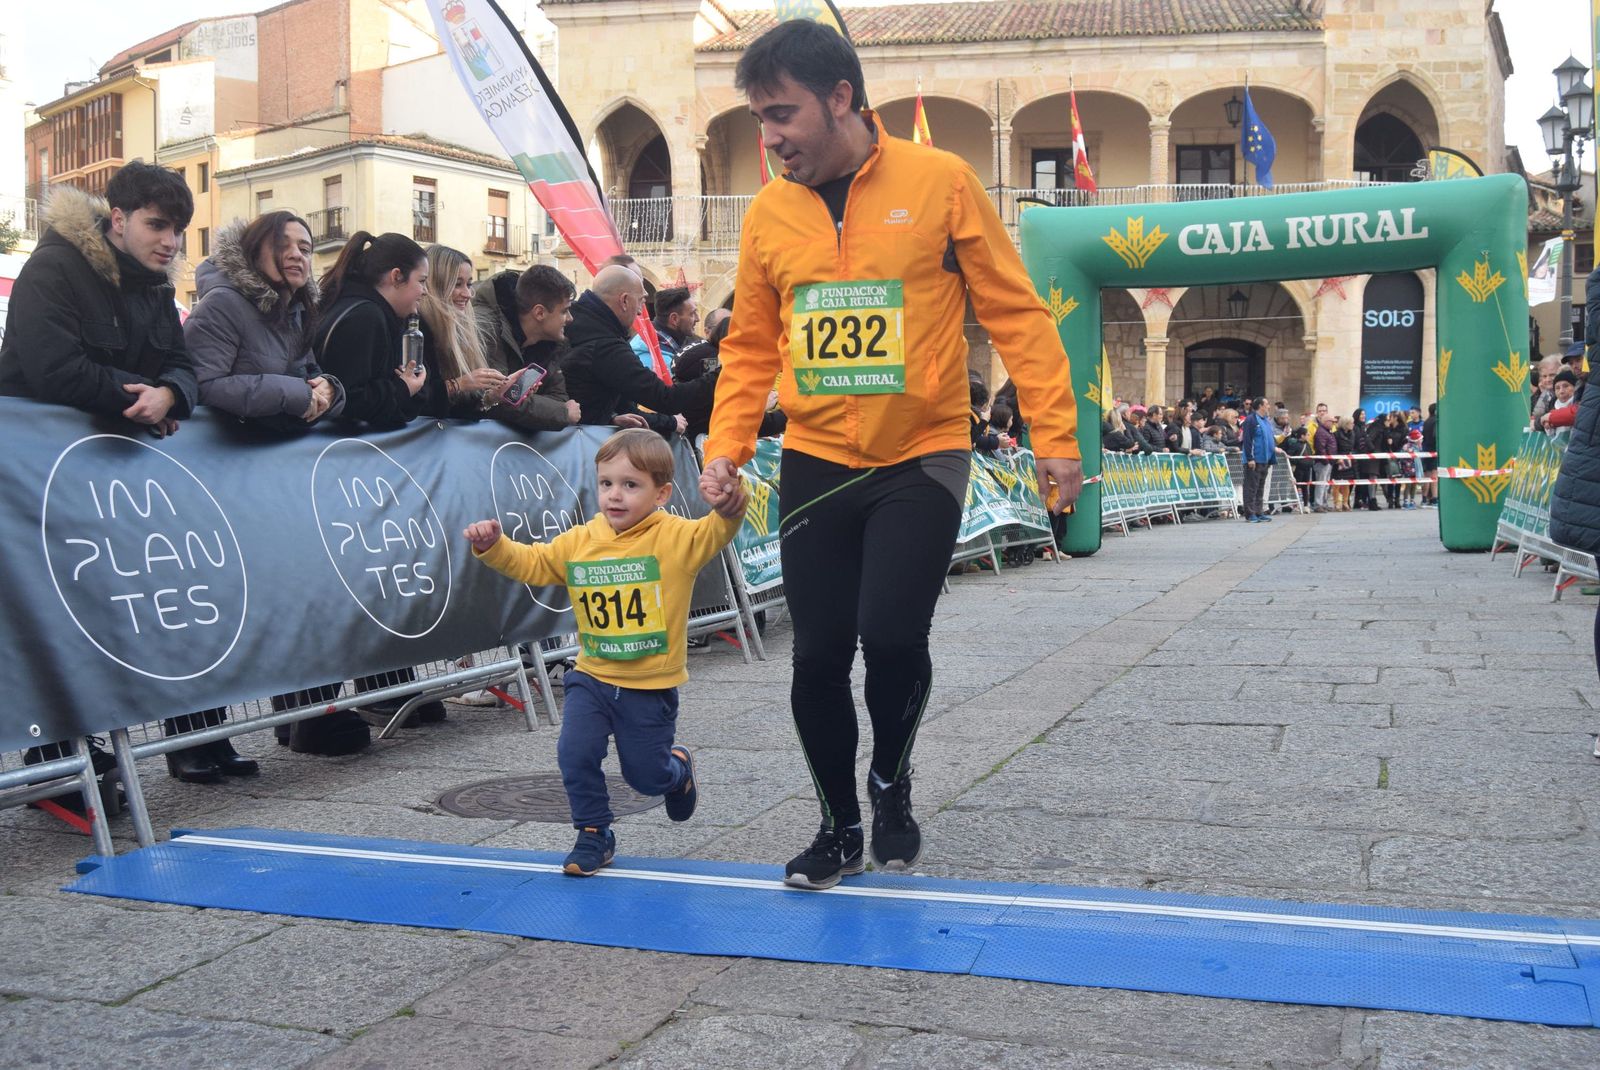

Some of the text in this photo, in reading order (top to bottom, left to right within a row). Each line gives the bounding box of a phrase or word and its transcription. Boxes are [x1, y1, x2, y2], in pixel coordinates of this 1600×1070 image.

[1177, 207, 1430, 256] CAJA RURAL
[821, 285, 888, 298] FUNDACION
[821, 298, 847, 308] CAJA
[849, 295, 888, 307] RURAL
[801, 314, 888, 361] 1232
[822, 373, 899, 388] CAJA RURAL
[1374, 400, 1402, 415] 016
[89, 478, 177, 519] IM
[338, 476, 401, 509] IM
[509, 473, 556, 501] IM
[331, 517, 436, 556] PLAN
[65, 530, 226, 581] PLAN
[587, 562, 647, 576] FUNDACION
[741, 545, 766, 565] CAJA
[365, 562, 435, 600] TES
[589, 574, 612, 585] CAJA
[612, 571, 647, 583] RURAL
[110, 584, 220, 635] TES
[579, 588, 647, 630] 1314
[600, 638, 662, 653] CAJA RURAL
